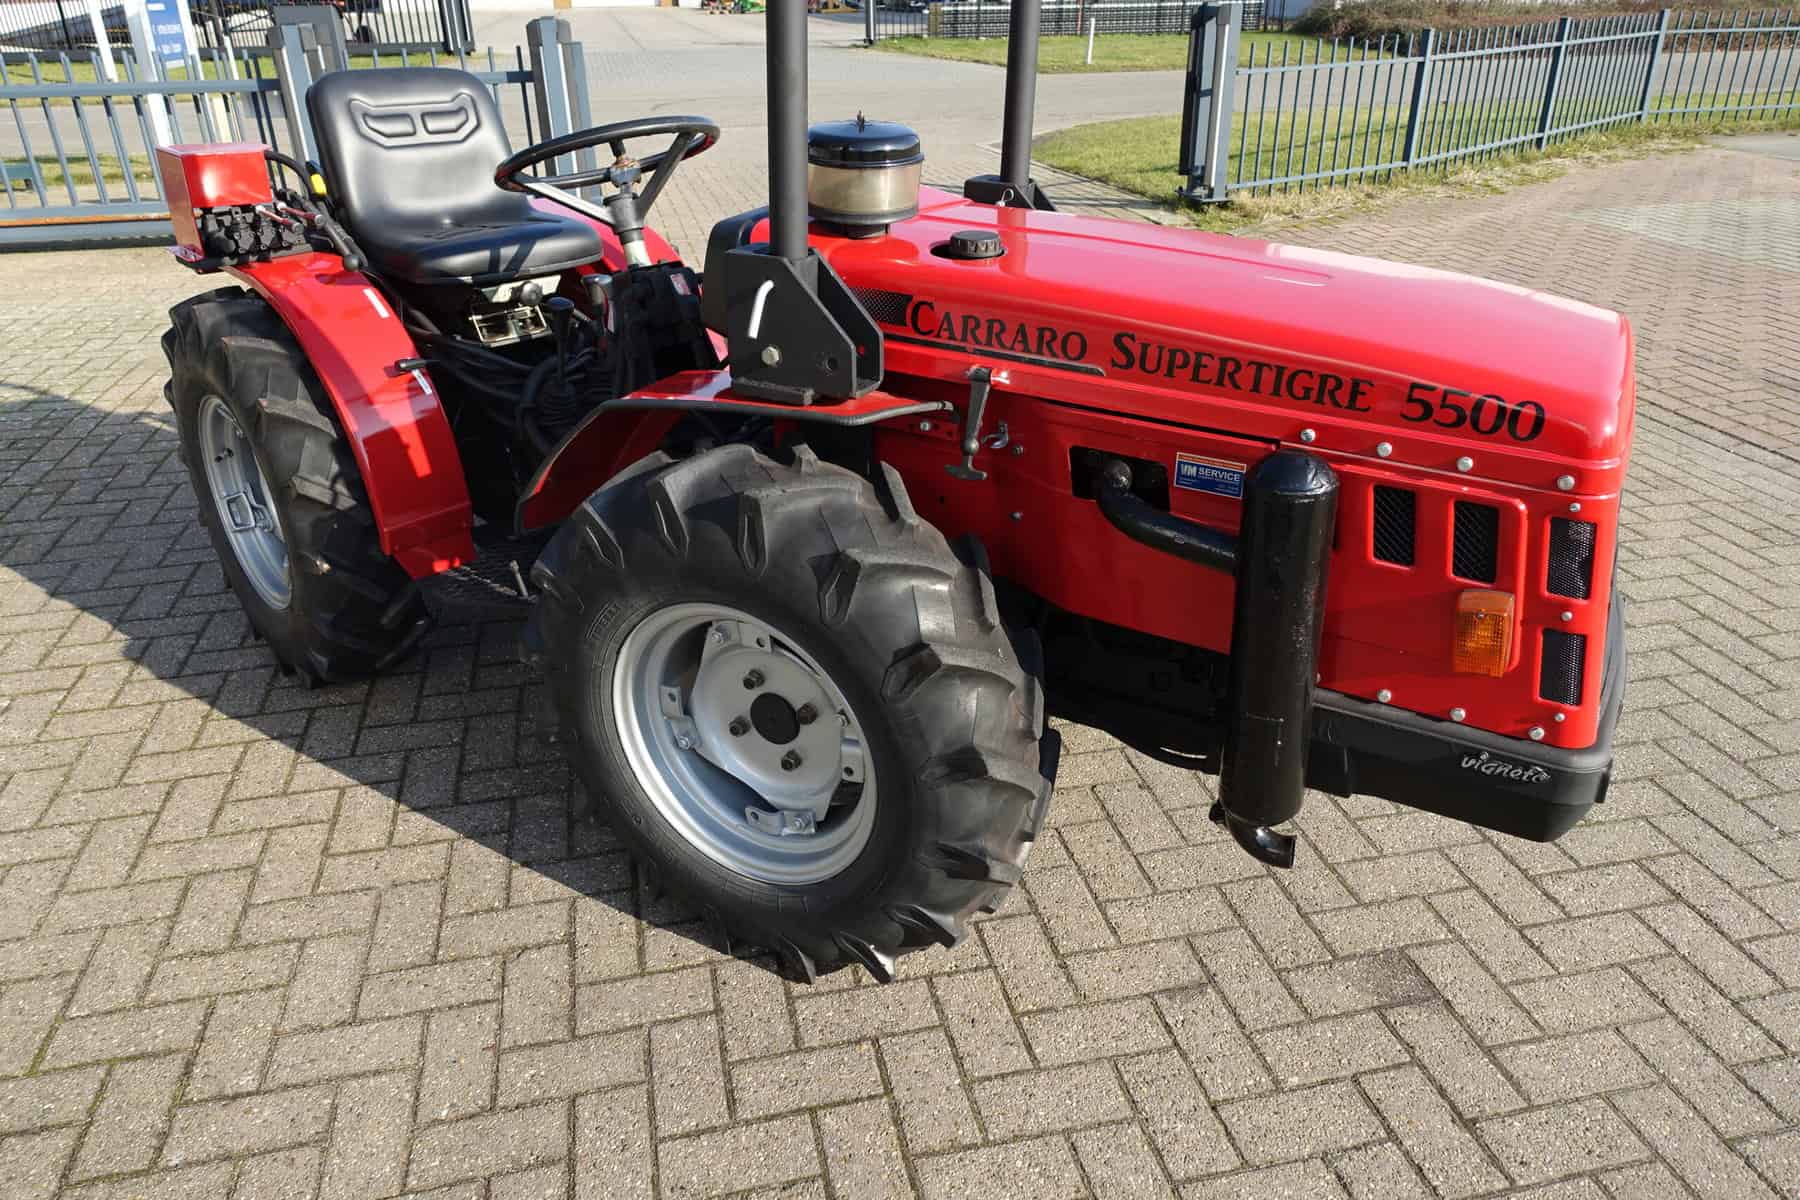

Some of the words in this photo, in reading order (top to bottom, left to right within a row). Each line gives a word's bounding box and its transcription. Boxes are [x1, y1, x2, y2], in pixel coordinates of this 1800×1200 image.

[910, 300, 1088, 362] CARRARO
[1111, 331, 1375, 413] SUPERTIGRE
[1401, 382, 1545, 442] 5500
[1198, 466, 1241, 482] SERVICE
